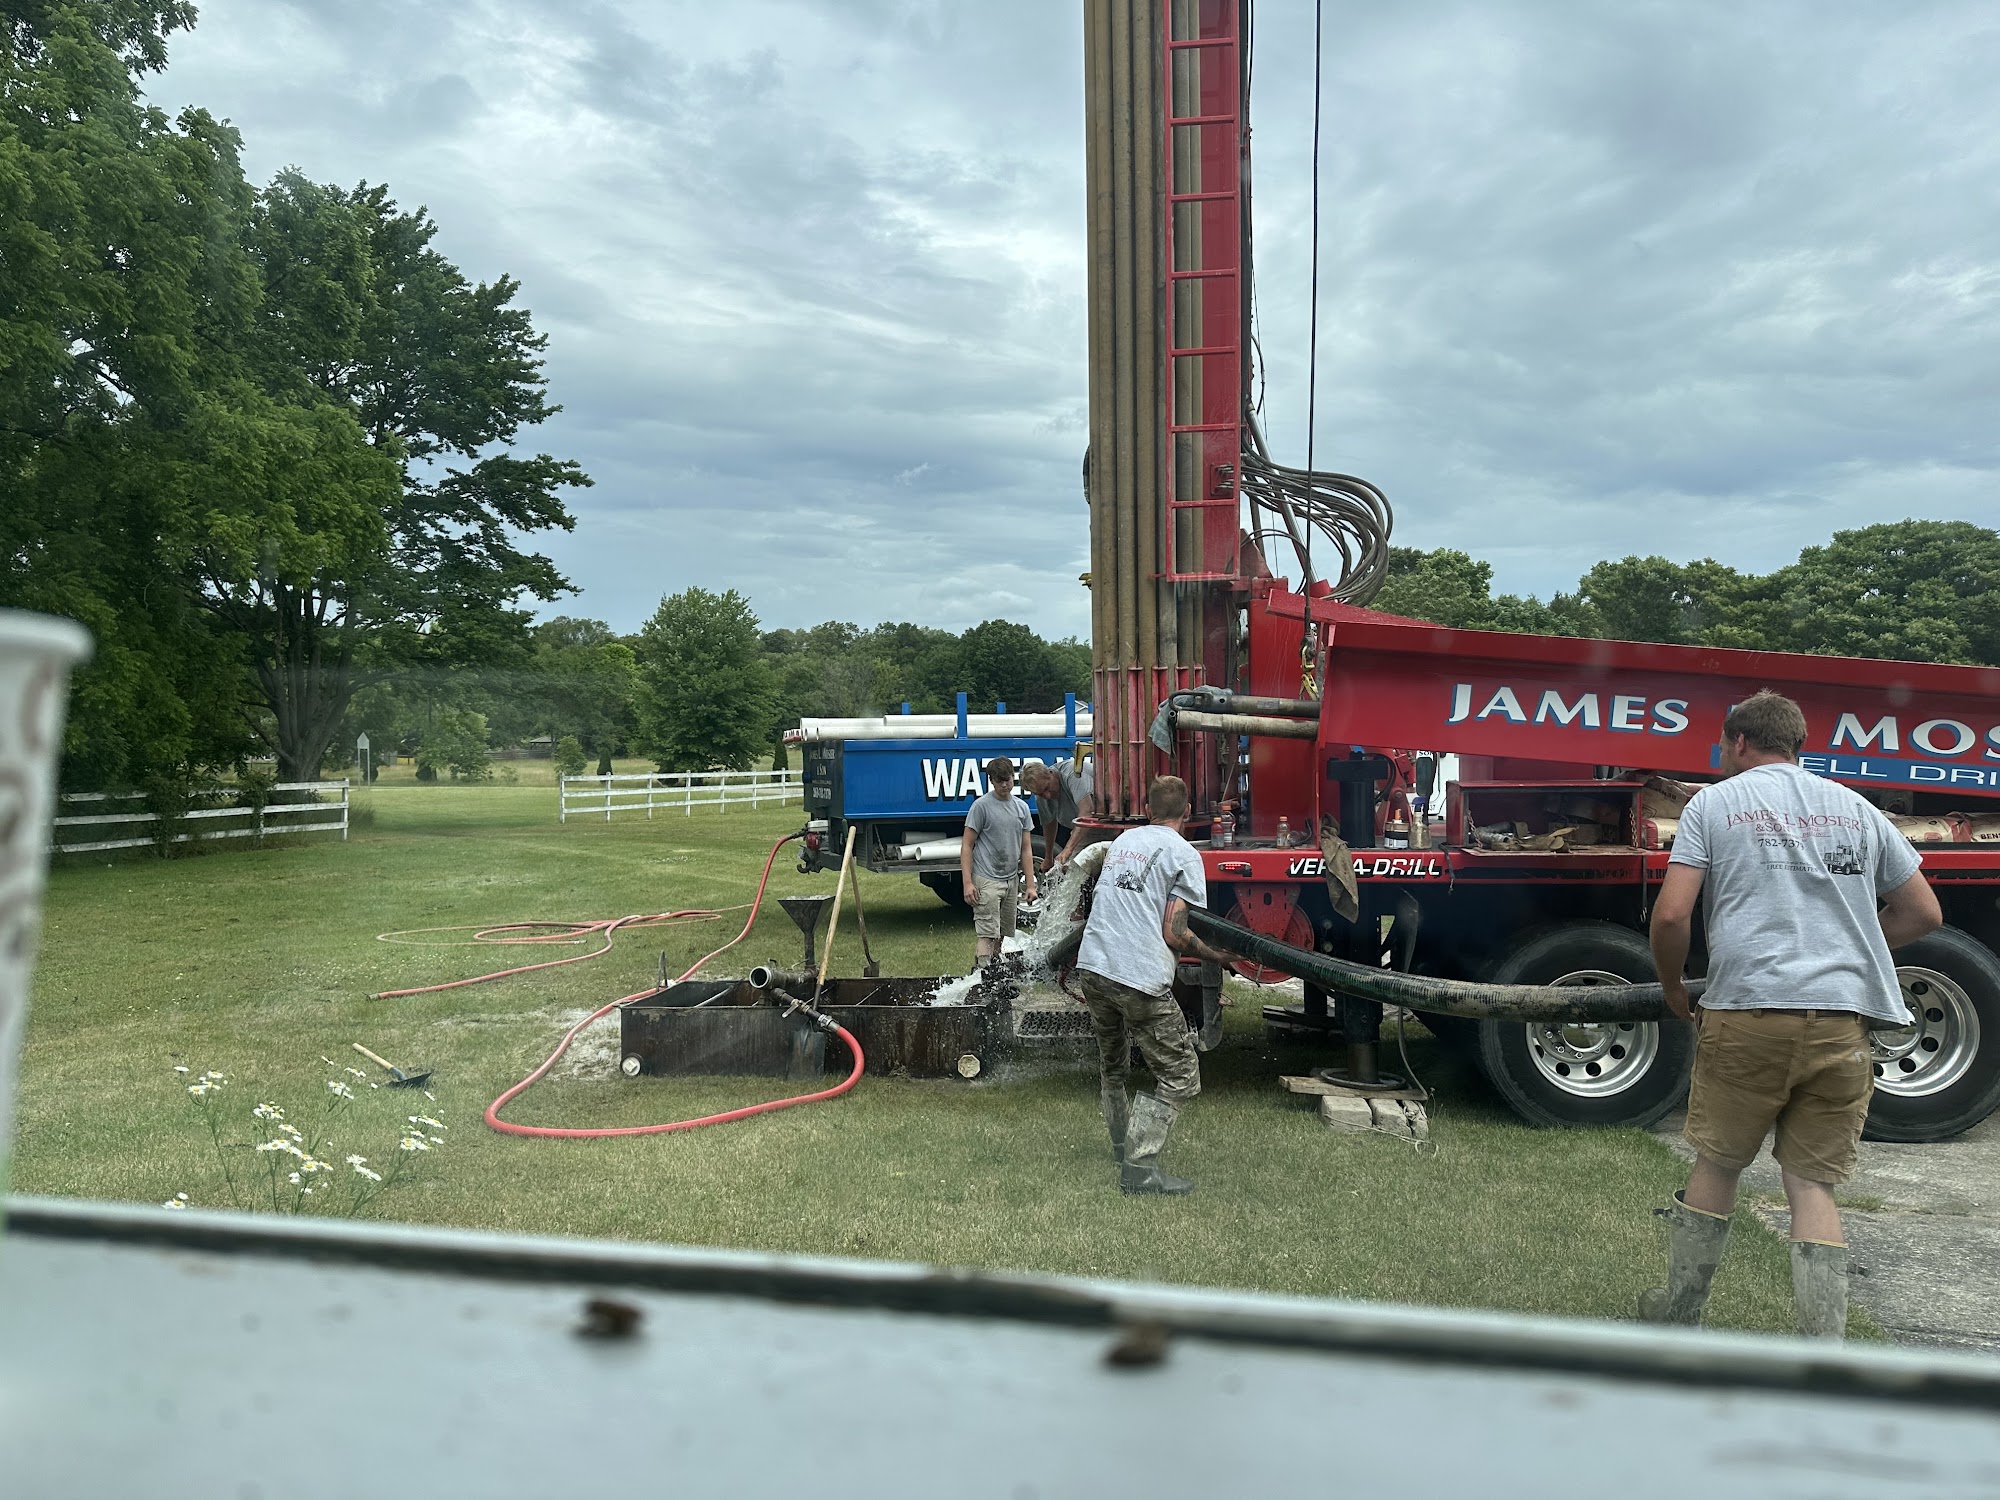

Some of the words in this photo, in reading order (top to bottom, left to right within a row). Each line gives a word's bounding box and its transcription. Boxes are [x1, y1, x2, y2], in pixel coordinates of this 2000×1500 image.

[1447, 683, 1689, 734] JAMES
[1797, 756, 1888, 777] ELL
[1726, 809, 1779, 831] JAMES
[1784, 813, 1796, 826] L
[1796, 814, 1860, 831] MOSIER
